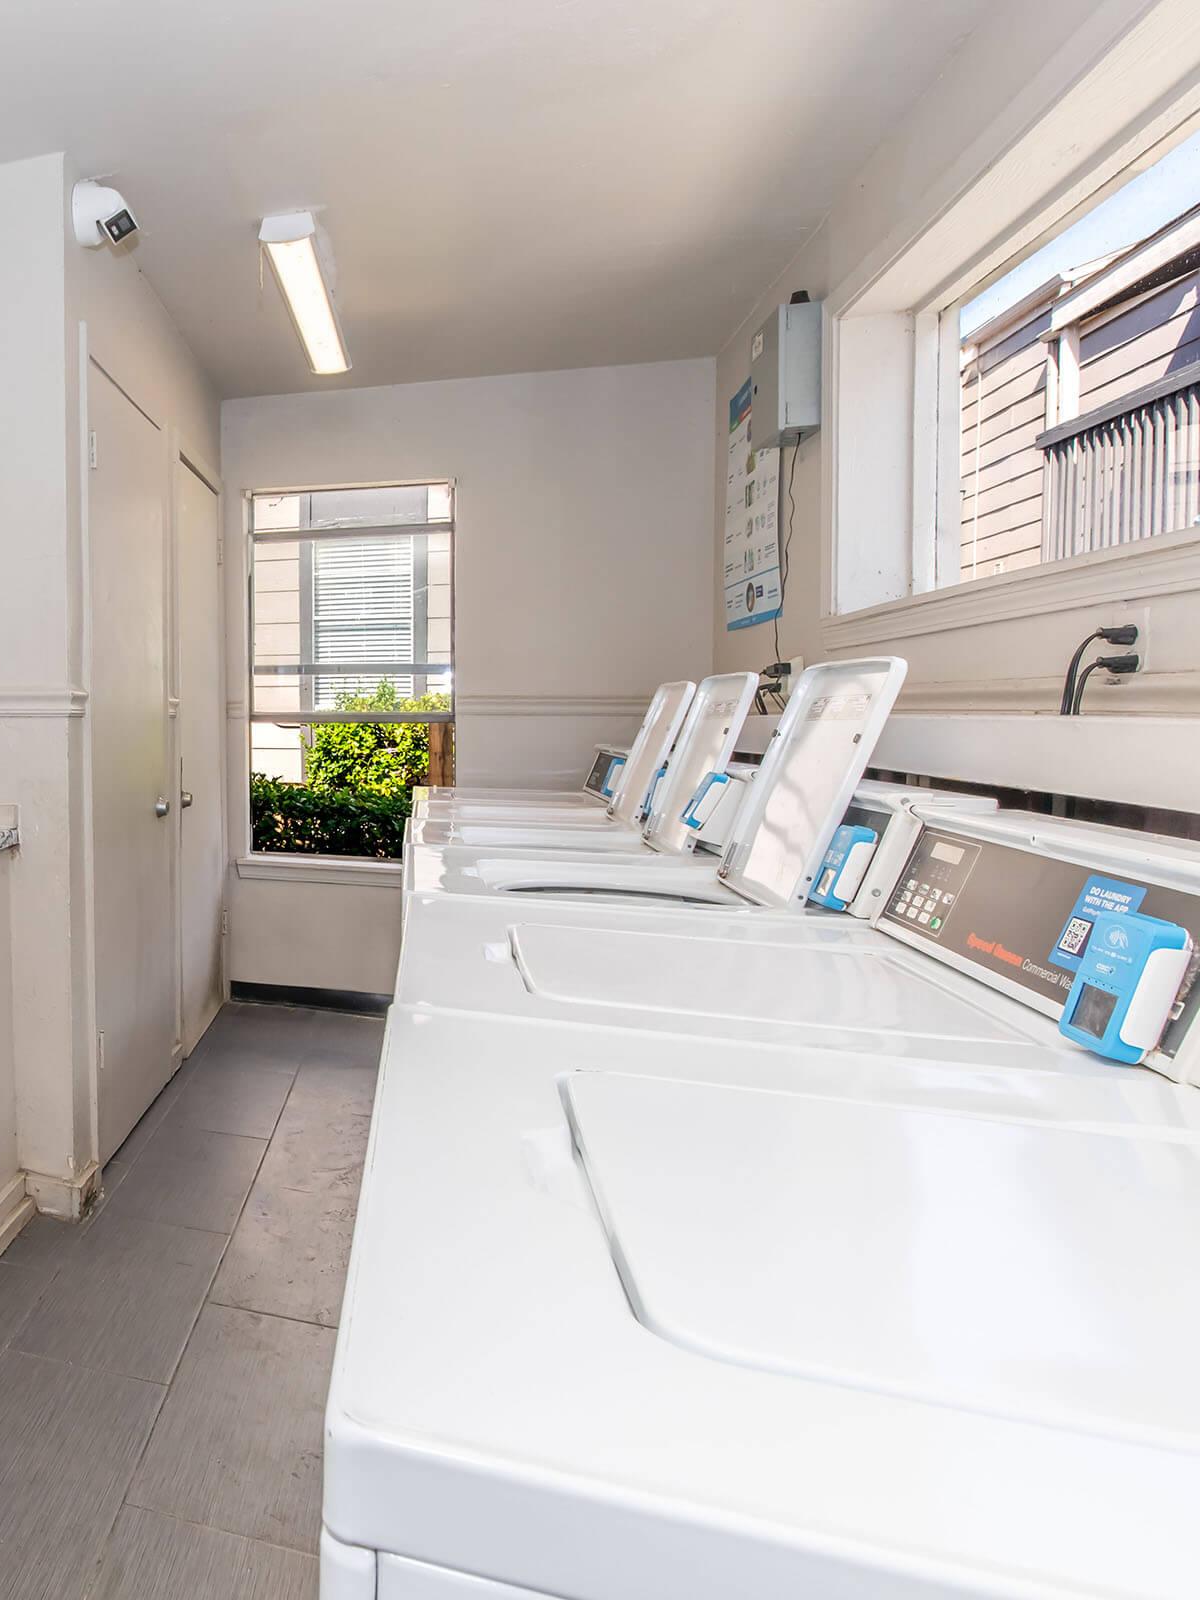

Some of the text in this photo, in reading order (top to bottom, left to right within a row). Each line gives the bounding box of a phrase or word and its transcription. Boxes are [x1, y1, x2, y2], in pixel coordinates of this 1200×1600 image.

[1084, 895, 1102, 907] WITH
[1102, 899, 1116, 911] THE
[1089, 886, 1133, 905] DO LAUNDRY
[1022, 958, 1060, 984] Commercial
